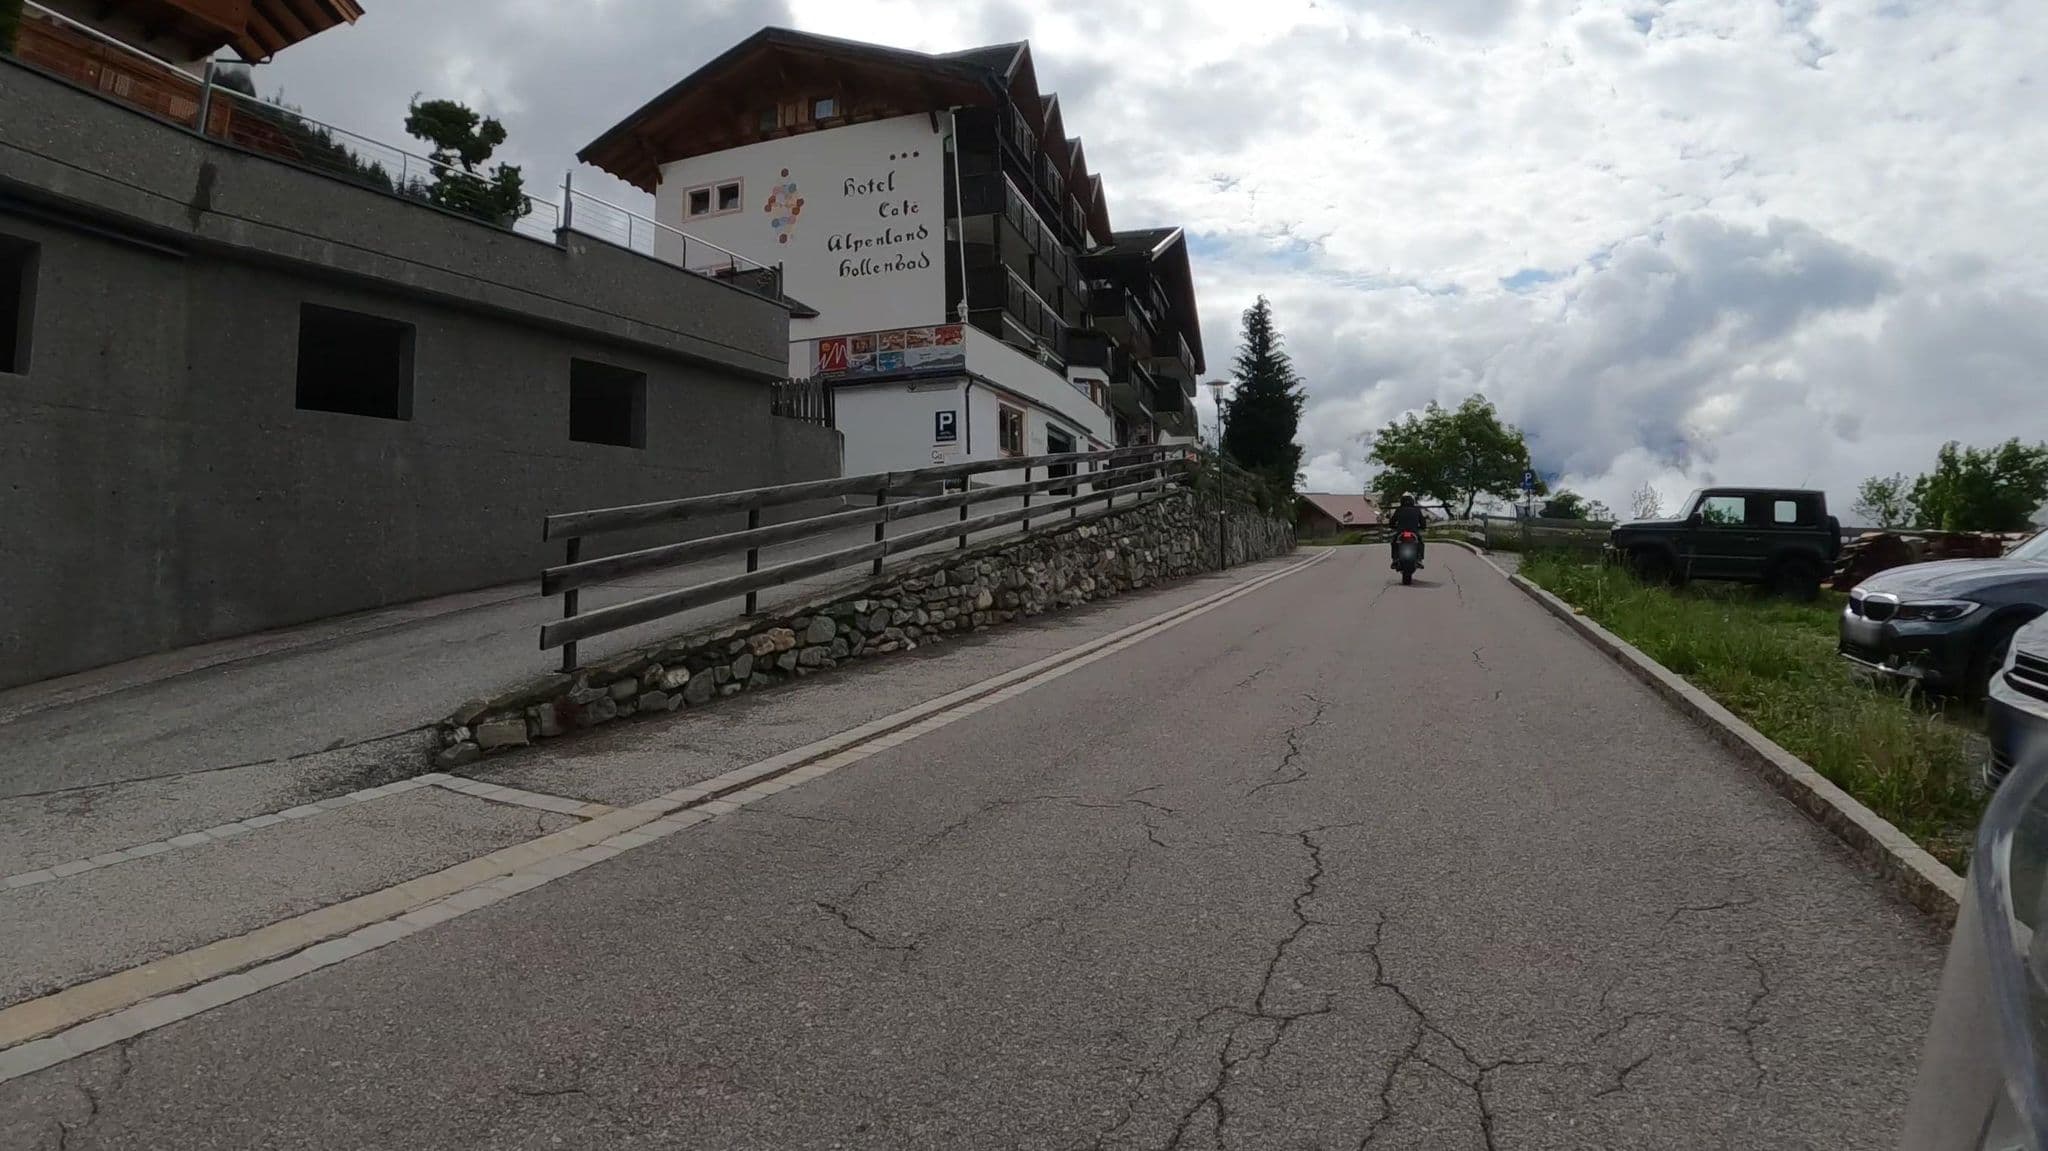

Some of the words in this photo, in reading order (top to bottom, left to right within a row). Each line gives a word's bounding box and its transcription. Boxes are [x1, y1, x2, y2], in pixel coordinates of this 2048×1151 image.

[844, 170, 895, 196] Hotel
[827, 224, 928, 252] Alpenland
[940, 412, 953, 431] P
